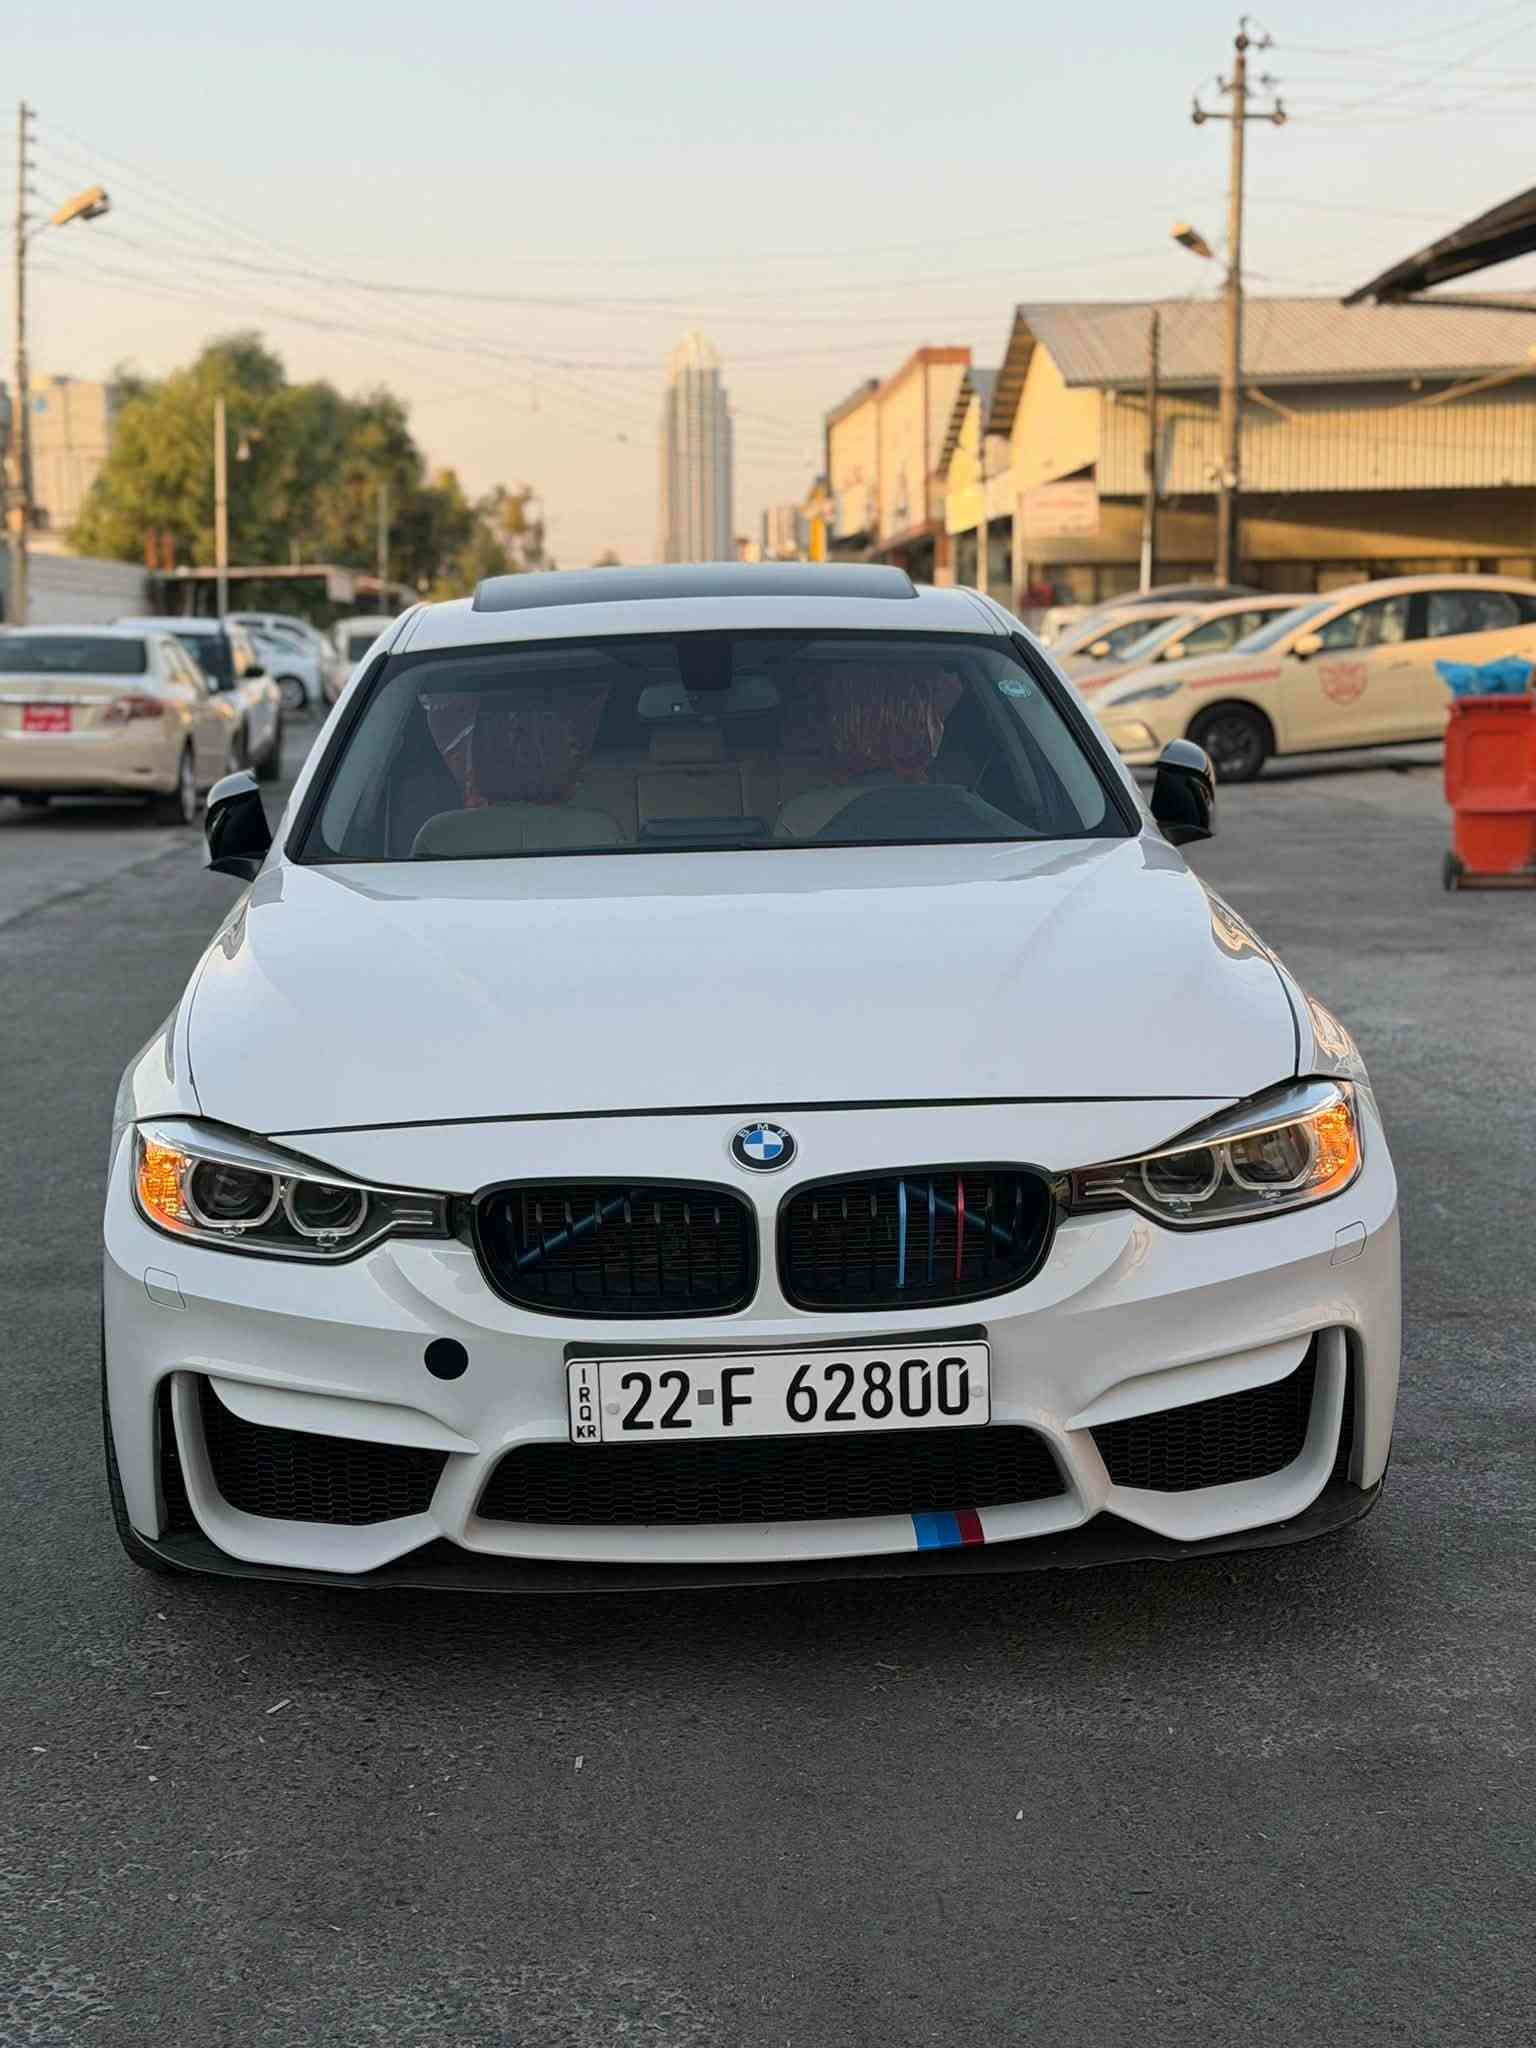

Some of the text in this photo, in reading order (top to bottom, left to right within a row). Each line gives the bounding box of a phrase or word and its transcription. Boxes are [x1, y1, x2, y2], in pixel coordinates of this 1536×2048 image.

[736, 1121, 789, 1138] BMW
[786, 1357, 969, 1422] 62800
[576, 1424, 596, 1438] KR
